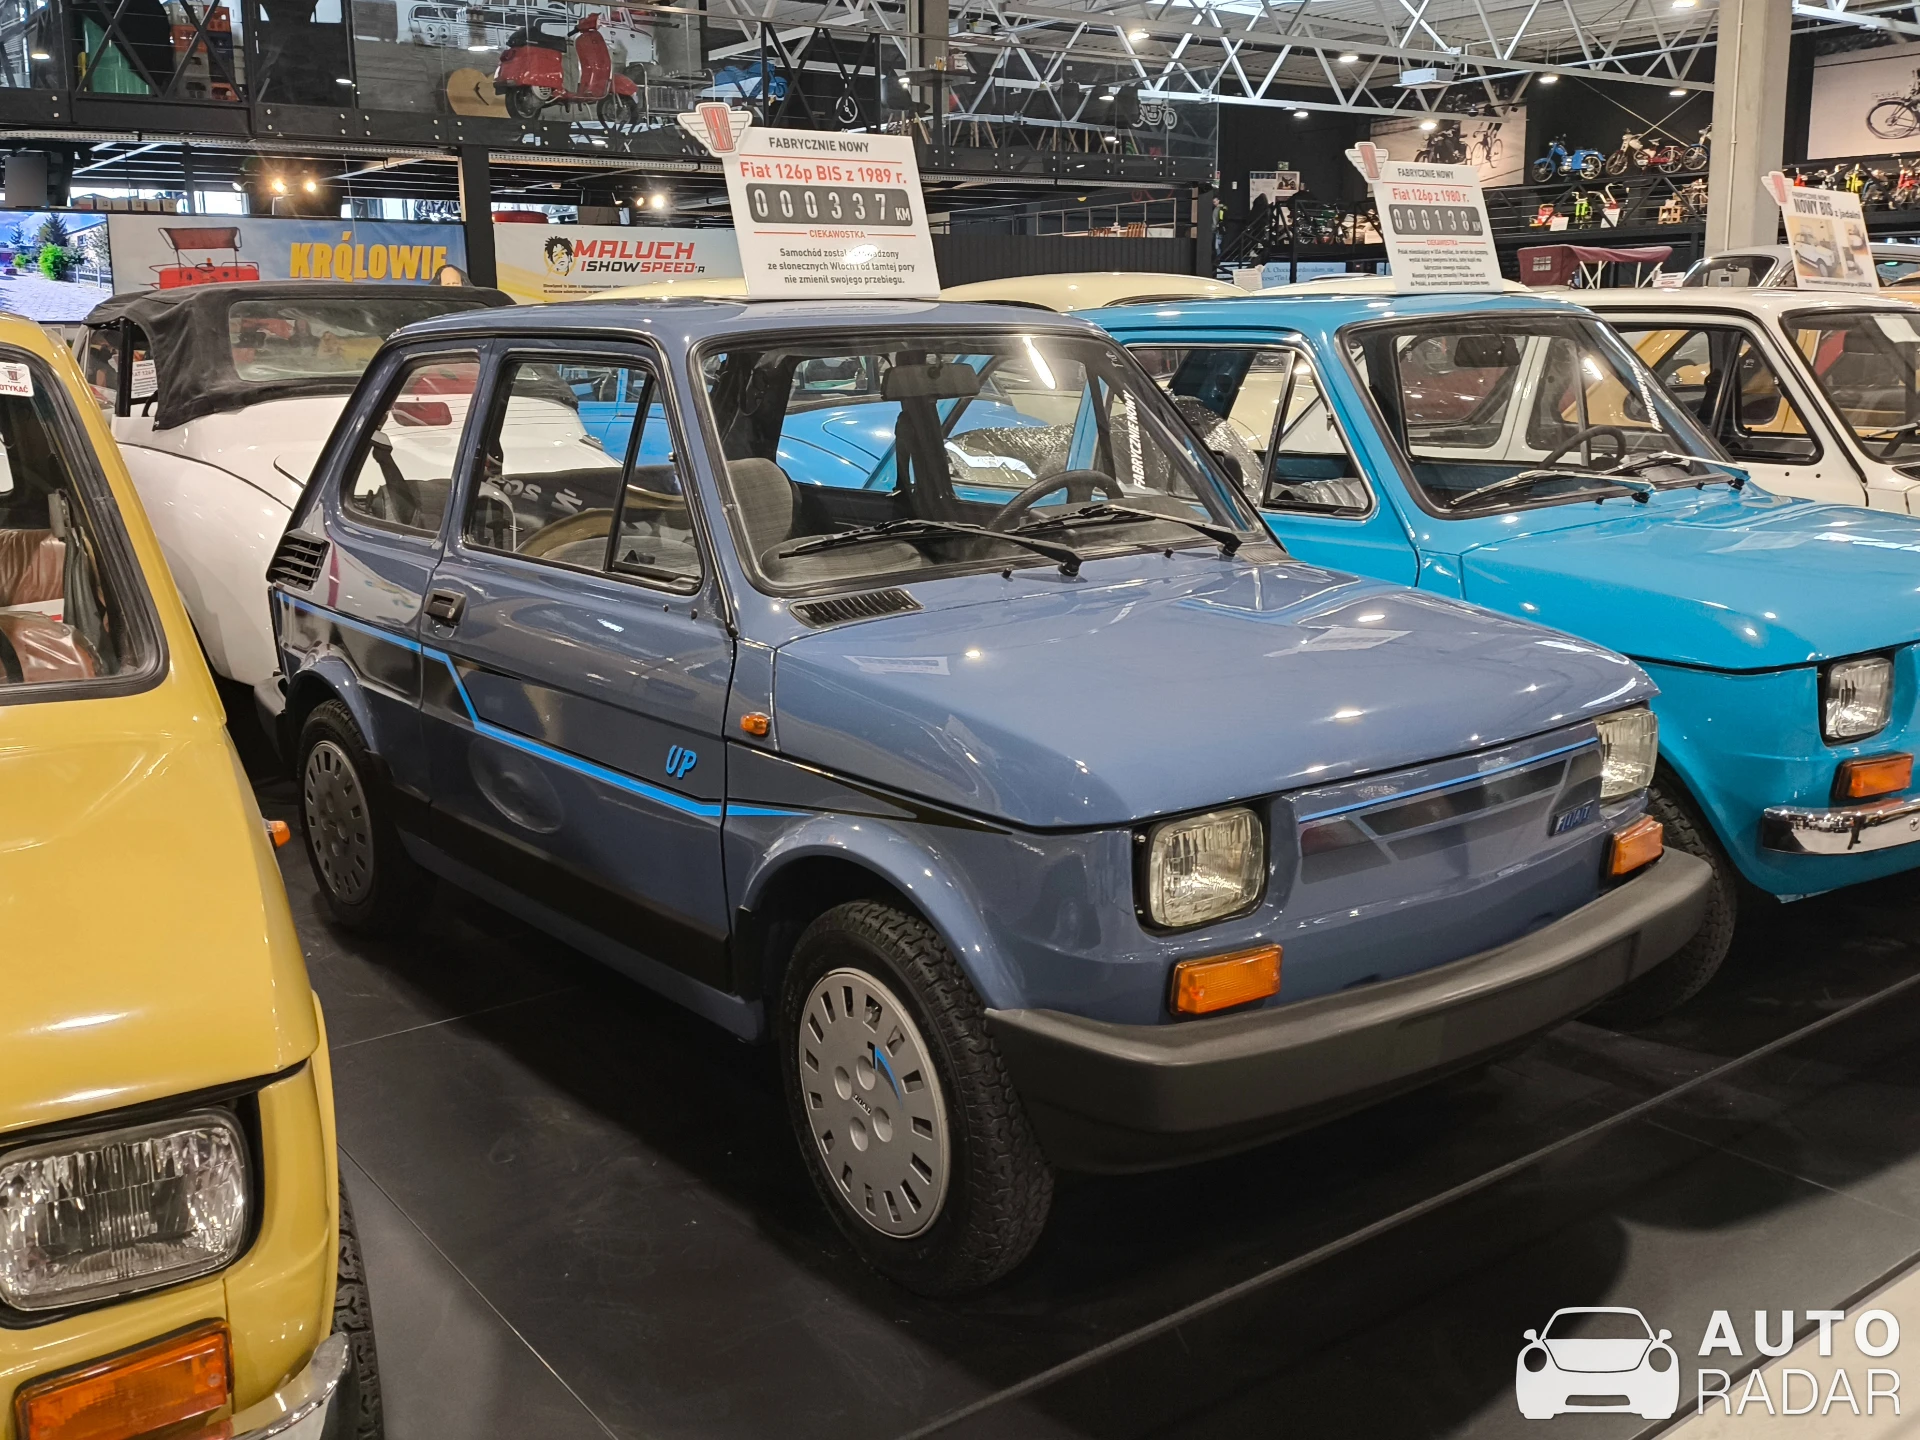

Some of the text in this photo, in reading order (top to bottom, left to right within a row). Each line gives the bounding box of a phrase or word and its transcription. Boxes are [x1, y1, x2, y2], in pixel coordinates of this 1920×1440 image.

[769, 137, 869, 153] FABRYCZNIE NOWY
[740, 162, 907, 184] Fiat 126p BIS z 1989 r.
[1397, 168, 1454, 179] FABRYCZNIE NOWY
[1392, 188, 1410, 200] Fiat
[1412, 189, 1433, 203] 126p
[1434, 193, 1440, 201] z
[1441, 190, 1461, 202] 1980
[895, 207, 911, 221] KM
[1793, 199, 1818, 215] NOWY
[809, 230, 866, 239] CIEKAWOSTKA
[574, 240, 695, 259] MALUCH
[780, 248, 822, 257] Samochód
[779, 262, 828, 271] słonecznych
[872, 262, 897, 272] tamtej
[898, 264, 915, 272] pory
[785, 275, 905, 285] nie zmienił swojego przebiegu.
[1122, 390, 1146, 490] FABRYCZNIE NOWY
[666, 745, 697, 779] UP
[1555, 806, 1591, 832] FIAT
